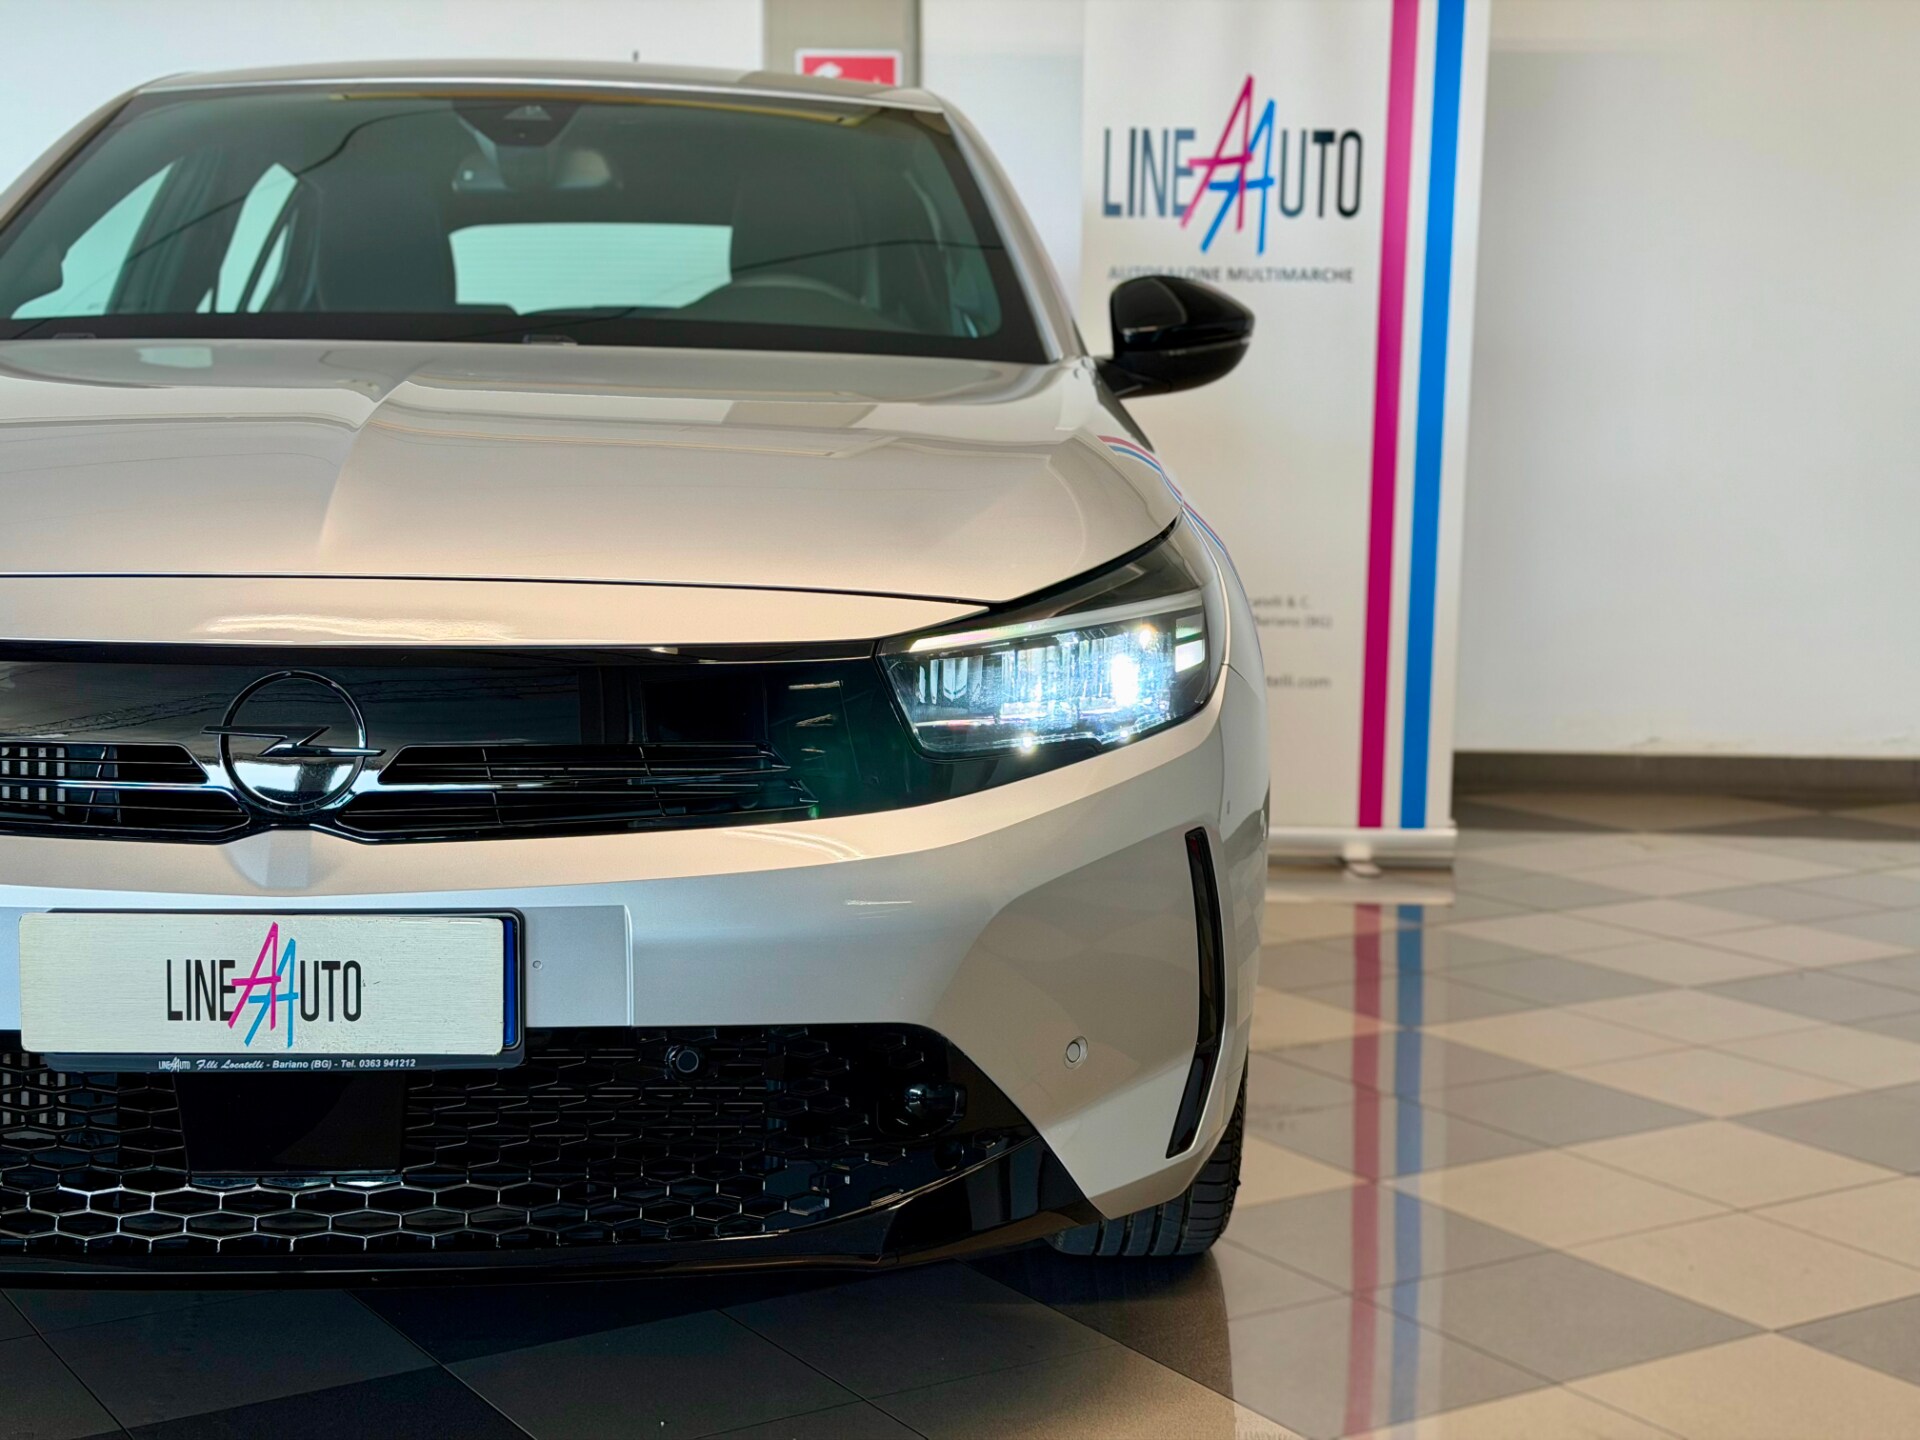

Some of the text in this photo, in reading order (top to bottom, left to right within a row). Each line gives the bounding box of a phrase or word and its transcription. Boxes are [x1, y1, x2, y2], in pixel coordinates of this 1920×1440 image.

[1226, 266, 1353, 284] MULTIMARCHE
[221, 1059, 264, 1069] Locatelli
[272, 1059, 308, 1069] Bariano
[311, 1060, 332, 1070] (BG)
[341, 1059, 356, 1068] Tel.
[359, 1059, 383, 1068] 0363
[383, 1058, 416, 1068] 941212
